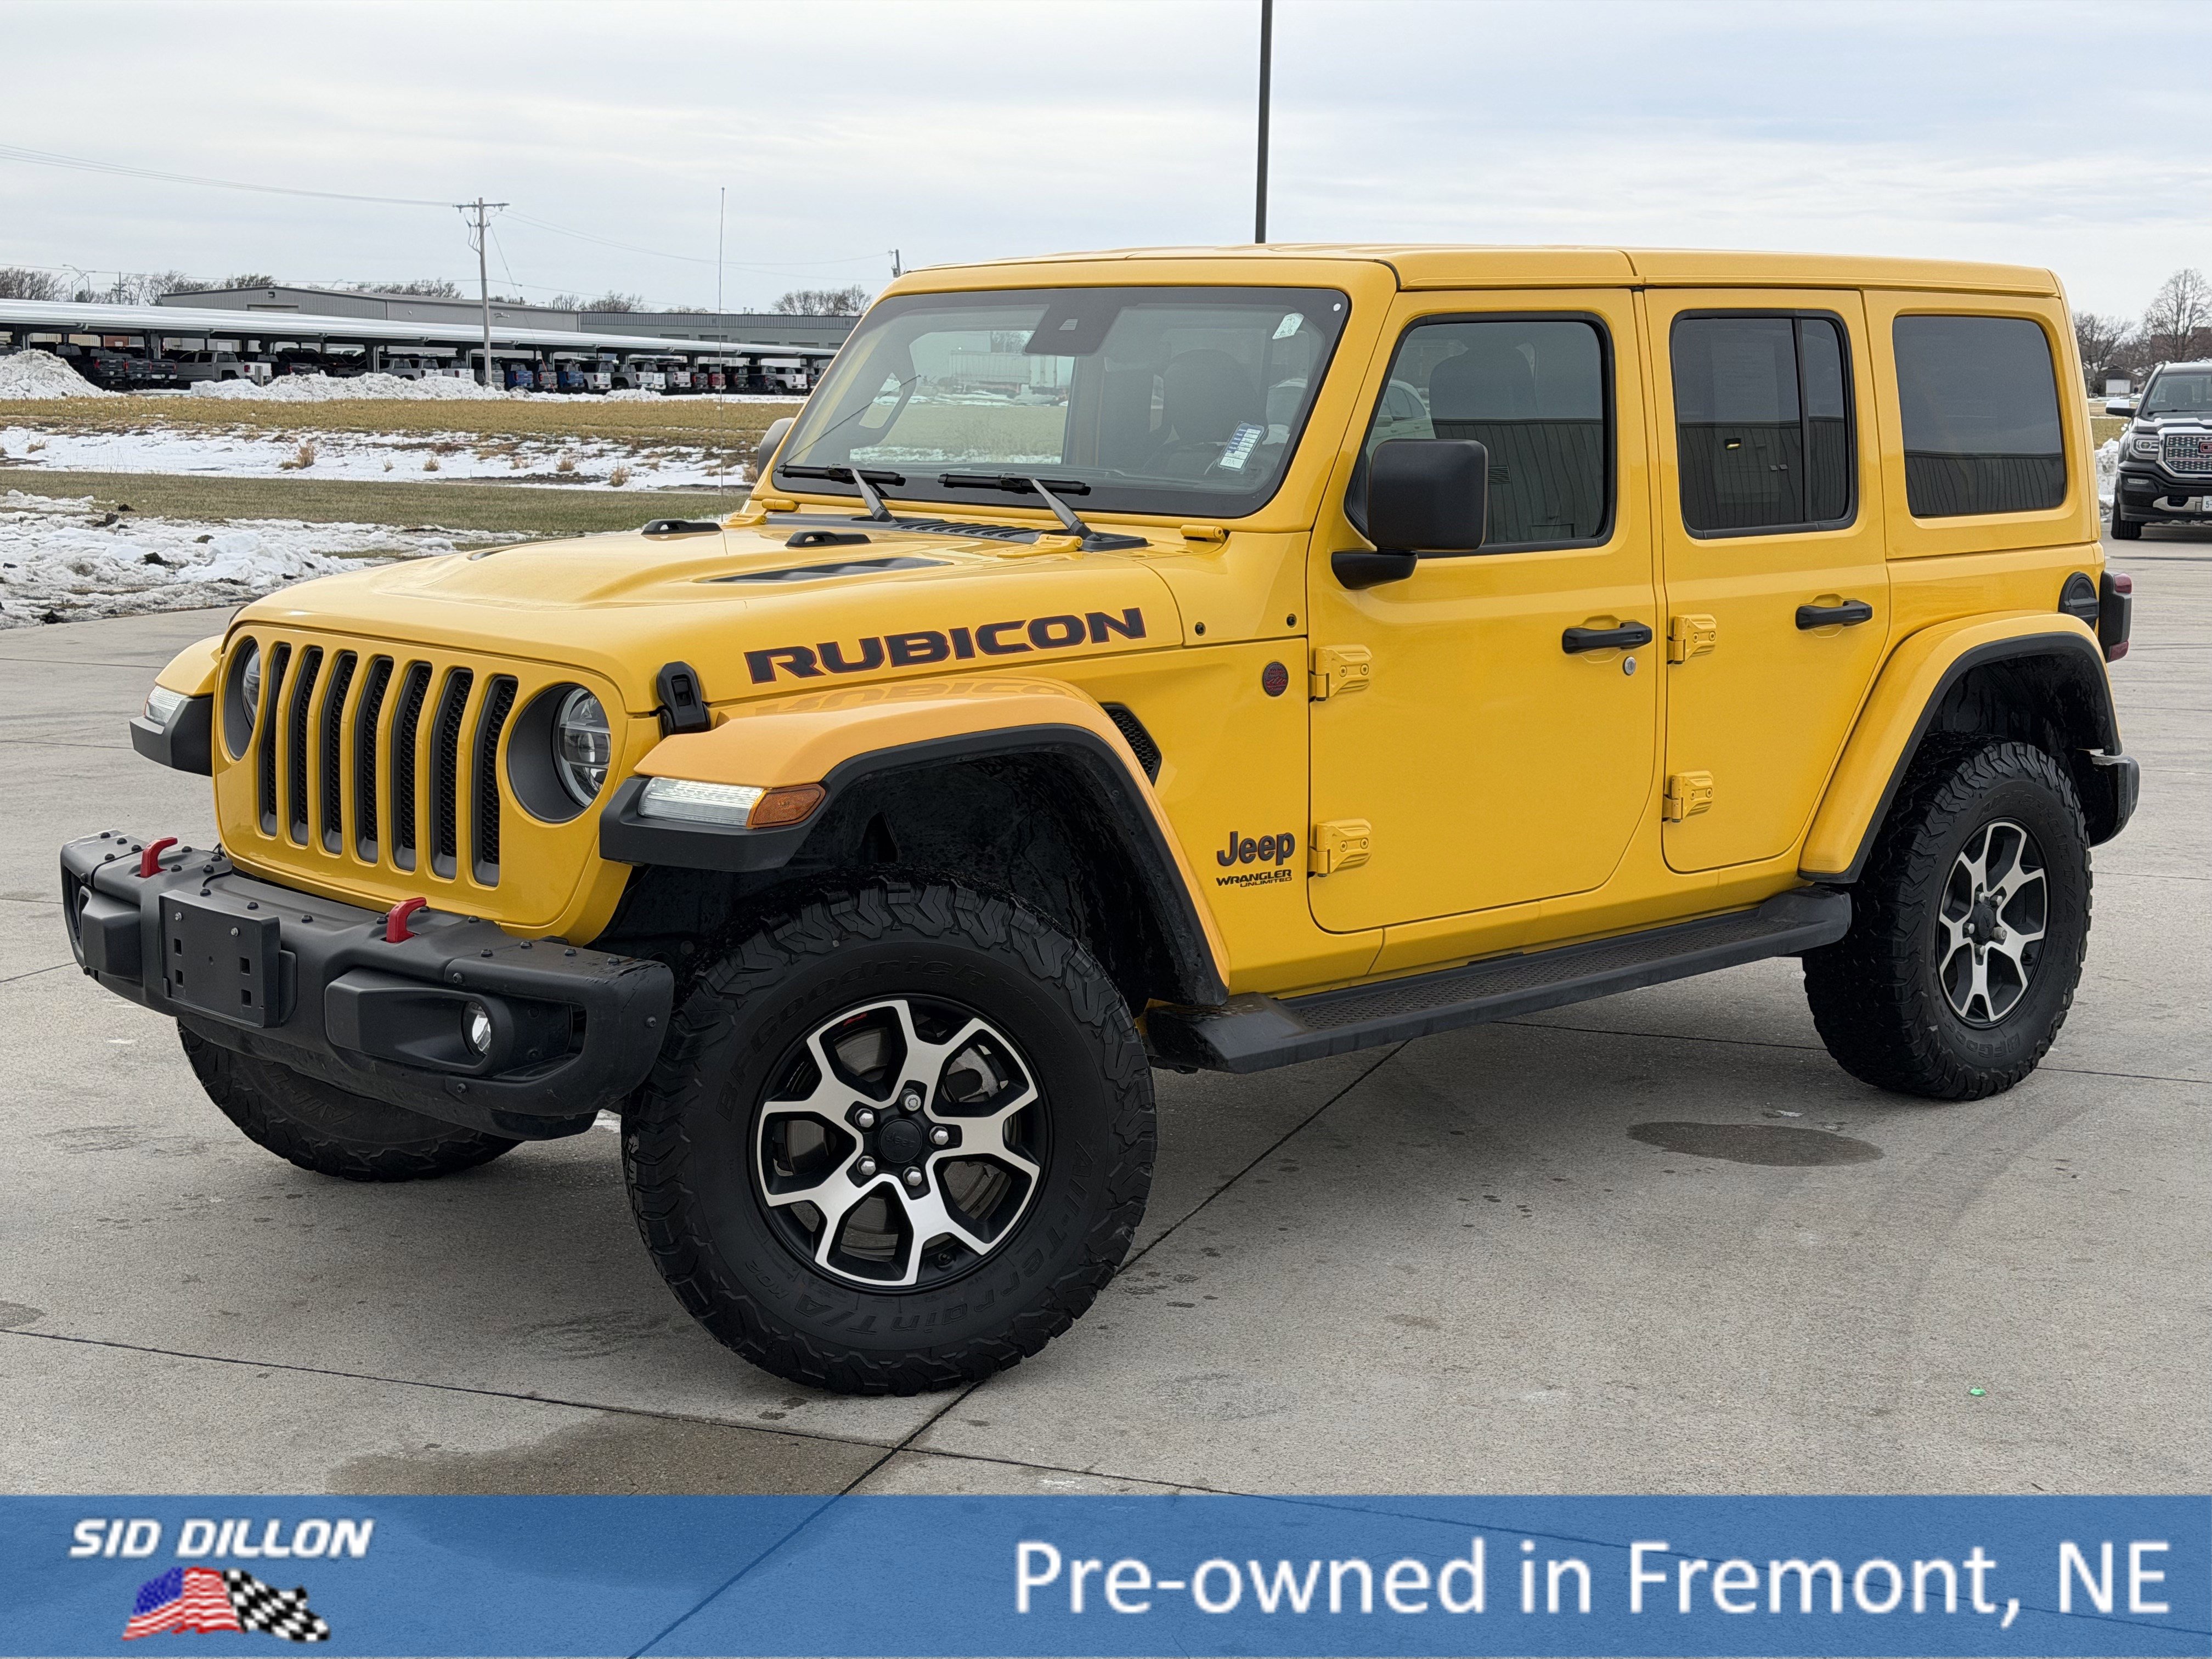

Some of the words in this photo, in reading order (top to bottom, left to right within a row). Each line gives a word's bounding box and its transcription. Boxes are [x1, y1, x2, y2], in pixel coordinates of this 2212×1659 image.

[743, 607, 1147, 685] RUBICON
[1216, 831, 1295, 866] Jeep
[1216, 869, 1292, 886] WRANGLER
[1239, 877, 1293, 888] UNLIMITED
